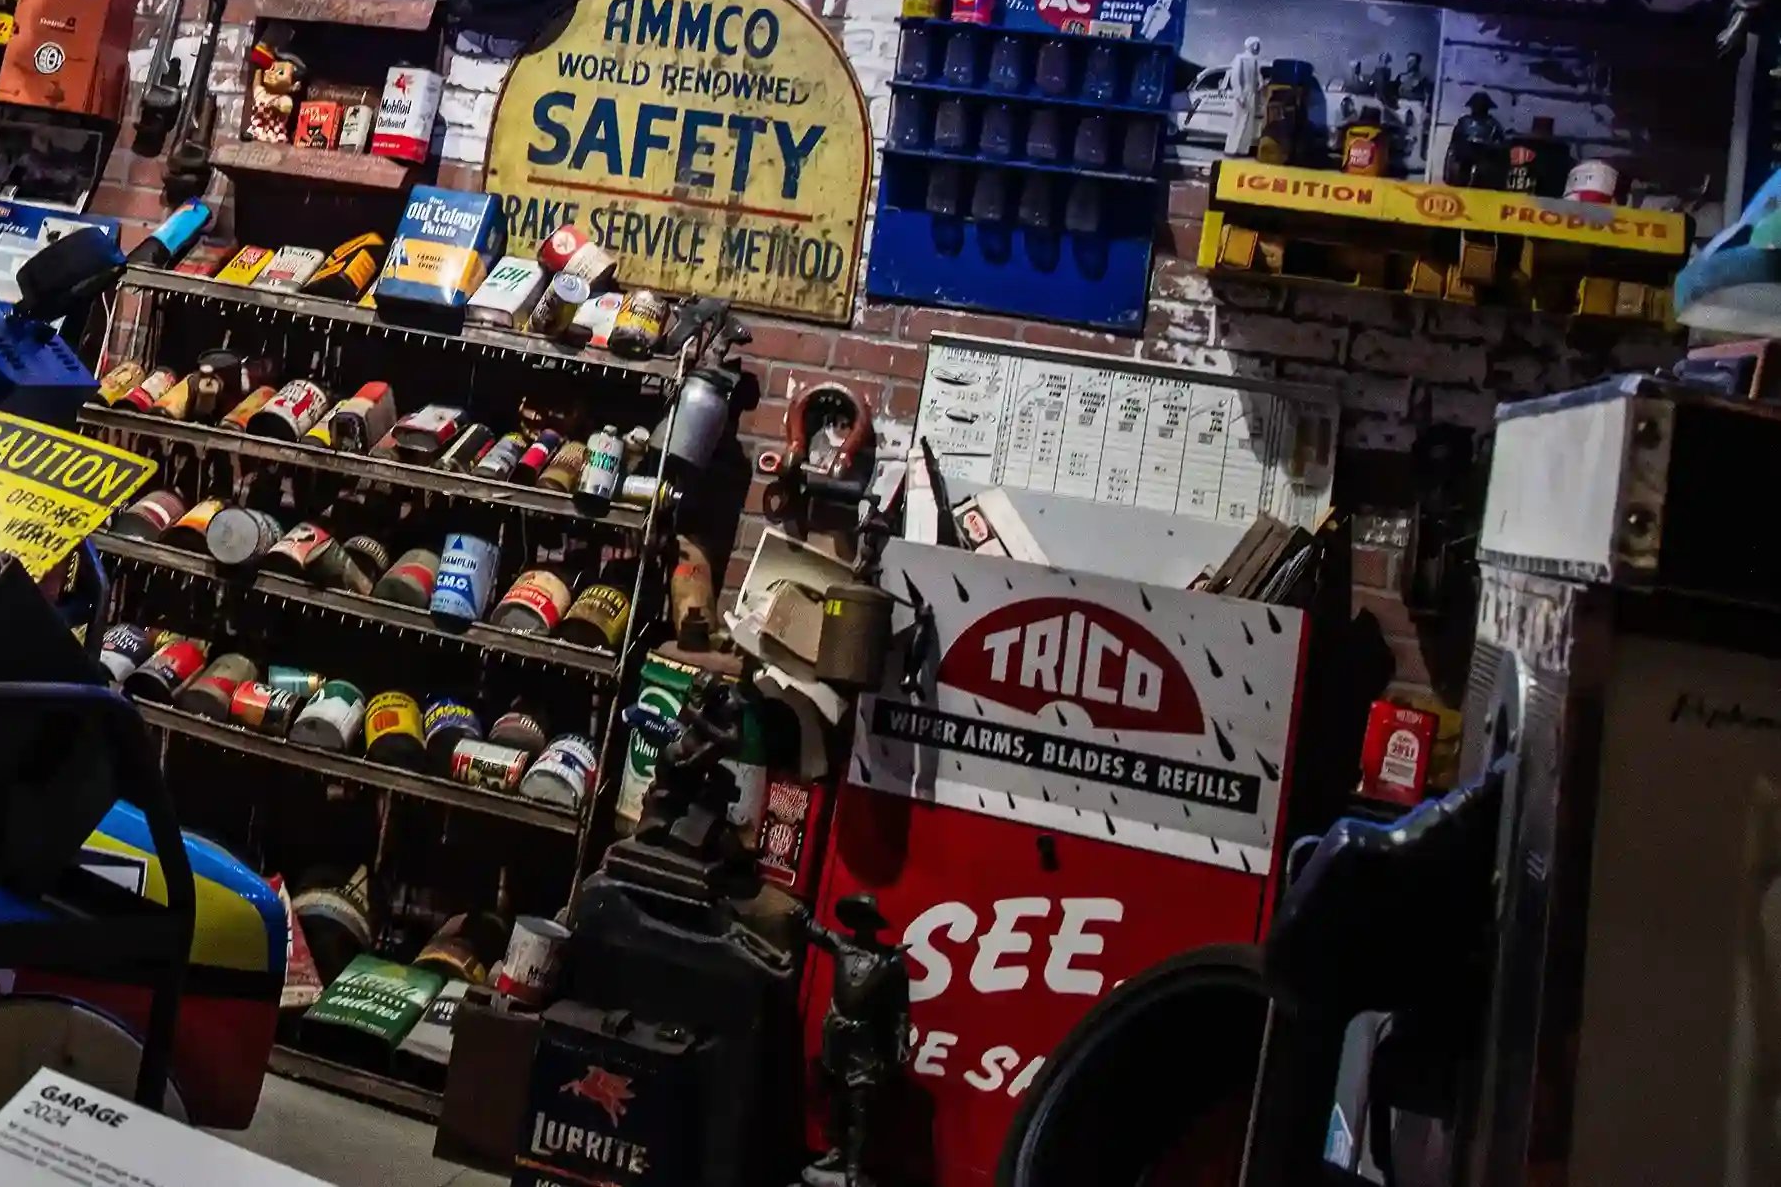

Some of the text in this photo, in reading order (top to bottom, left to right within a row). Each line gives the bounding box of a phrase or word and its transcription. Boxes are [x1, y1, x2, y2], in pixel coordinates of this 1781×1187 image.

[558, 51, 811, 107] WORLD RENOWNED
[527, 91, 827, 200] SAFETY
[406, 201, 481, 231] Old Colony
[1236, 172, 1373, 205] IGNITION
[502, 194, 845, 285] RAKE SERVICE METHOD
[982, 611, 1165, 713] TRICO
[887, 709, 1243, 804] WIPER ARMS, BLADES & REFILLS
[902, 896, 1125, 1002] SEE
[23, 1099, 72, 1129] 2024
[40, 1084, 129, 1128] GARAGE
